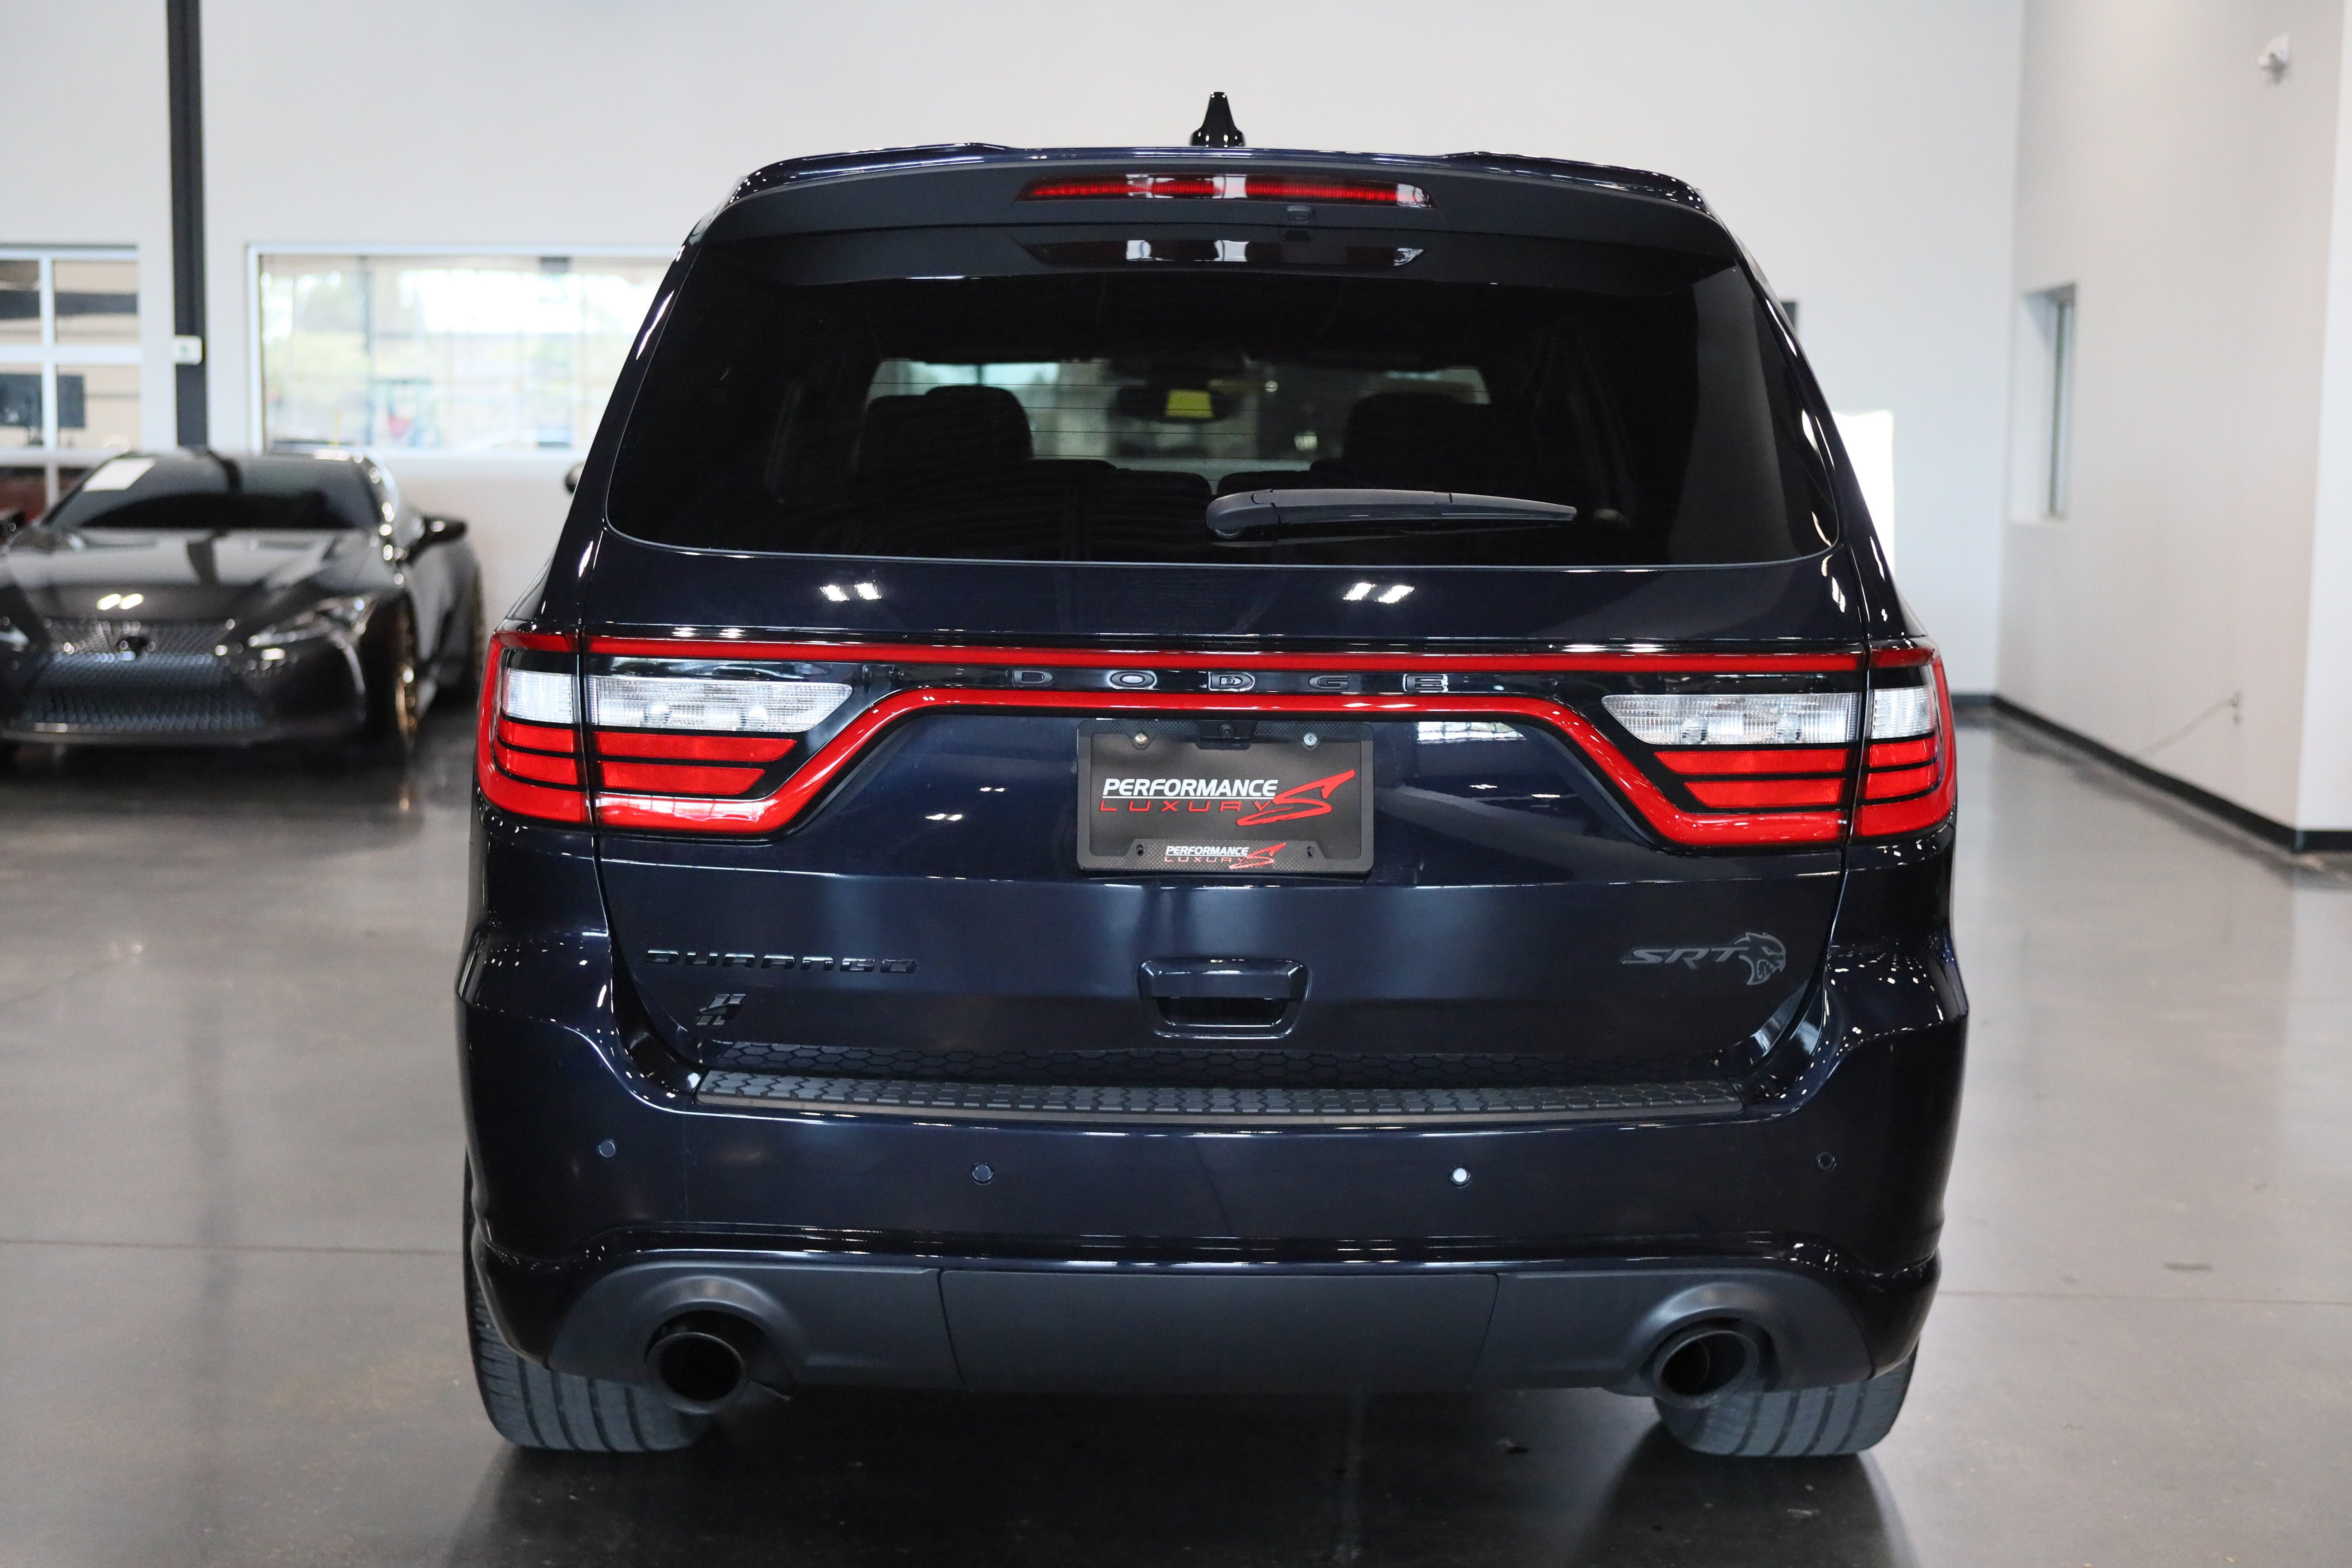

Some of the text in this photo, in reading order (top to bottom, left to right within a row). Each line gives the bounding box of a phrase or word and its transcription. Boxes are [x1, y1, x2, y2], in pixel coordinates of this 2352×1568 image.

[1011, 668, 1448, 692] DODGE
[1103, 778, 1278, 797] PERFORMANCE
[1100, 800, 1271, 812] LUXURY
[1165, 846, 1249, 855] PERFORMANCE
[644, 950, 918, 973] DURANGO
[1621, 948, 1750, 969] SRT
